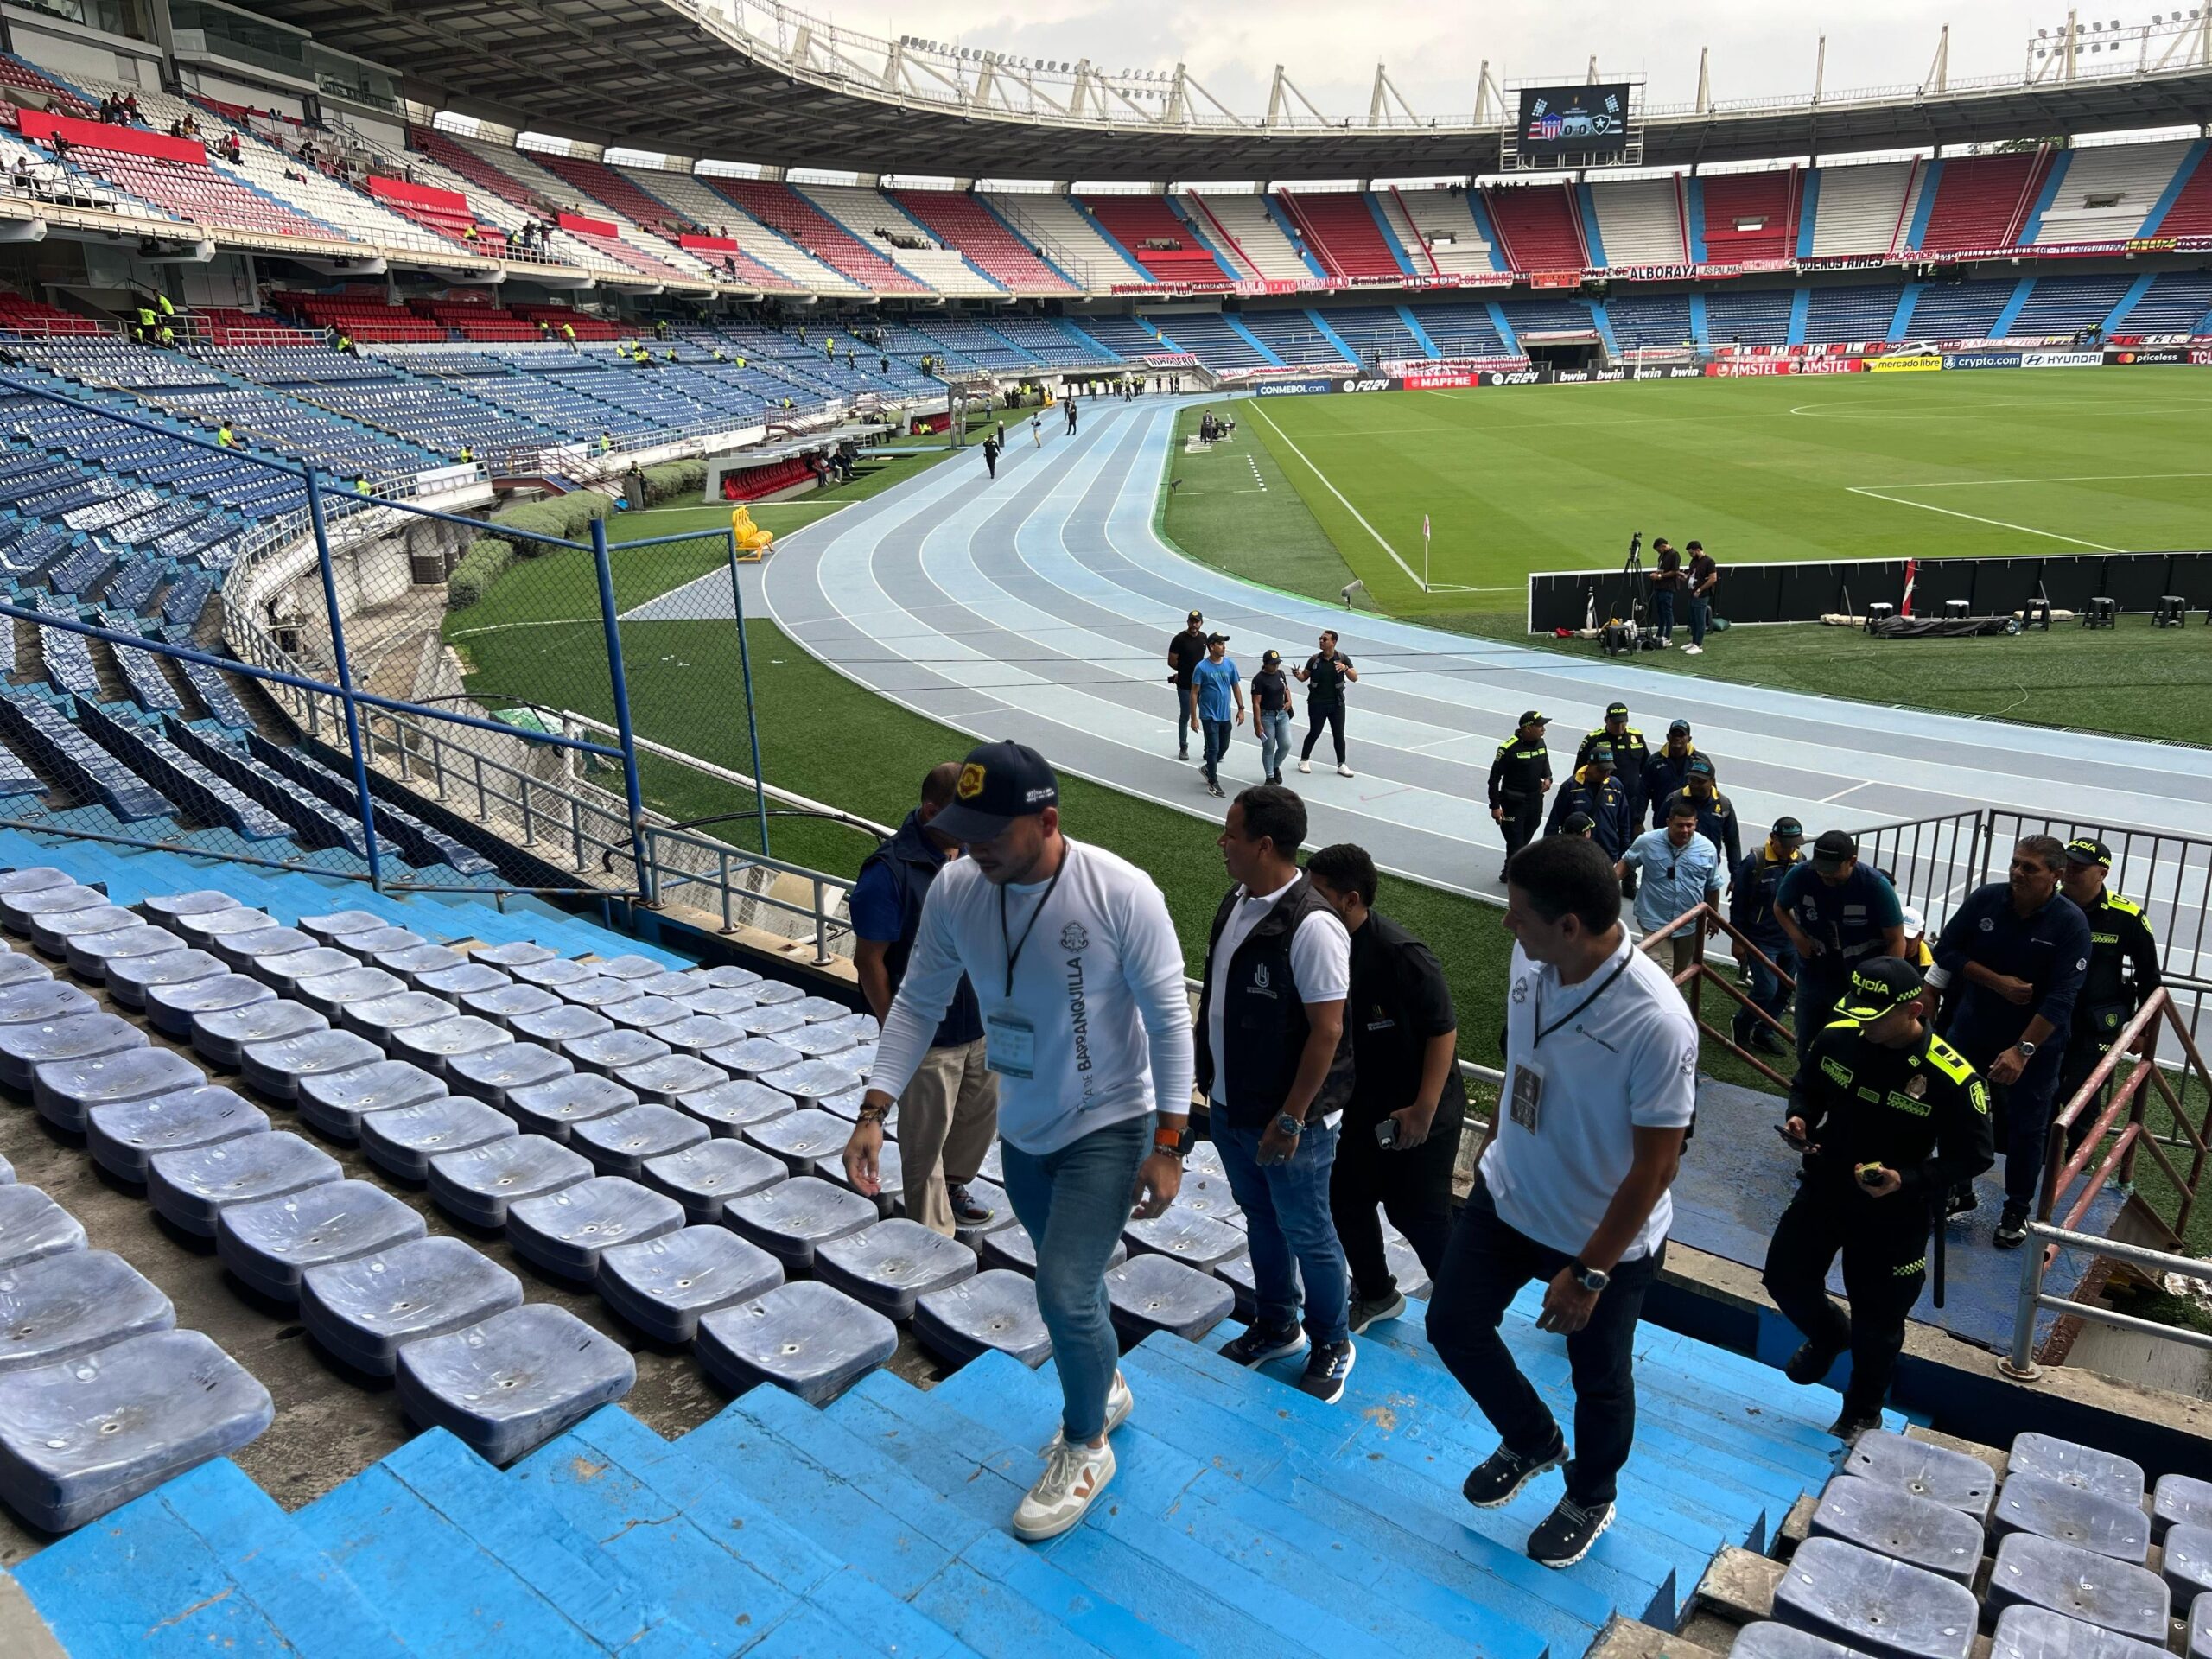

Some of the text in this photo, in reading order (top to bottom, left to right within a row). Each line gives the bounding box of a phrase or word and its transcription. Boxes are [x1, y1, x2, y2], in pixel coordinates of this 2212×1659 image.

[1846, 255, 1885, 268] AIRES
[1630, 264, 1697, 280] ALBORAYA
[1713, 264, 1742, 274] PALMAS
[1406, 275, 1433, 288] LOS
[1878, 359, 1940, 368] mercado libre
[1958, 357, 2019, 369] crypto.com
[2047, 355, 2101, 365] HYUNDAI
[2137, 353, 2177, 363] priceless
[2190, 351, 2212, 364] TCL
[1730, 363, 1778, 375] AMSTEL
[1802, 361, 1851, 373] AMSTEL
[1560, 366, 1699, 382] bwin bwin bwin bwin
[1421, 376, 1471, 387] MAPFRE
[1260, 384, 1326, 396] CONMEBOL.com
[1065, 957, 1093, 1072] BARRANQUILLA
